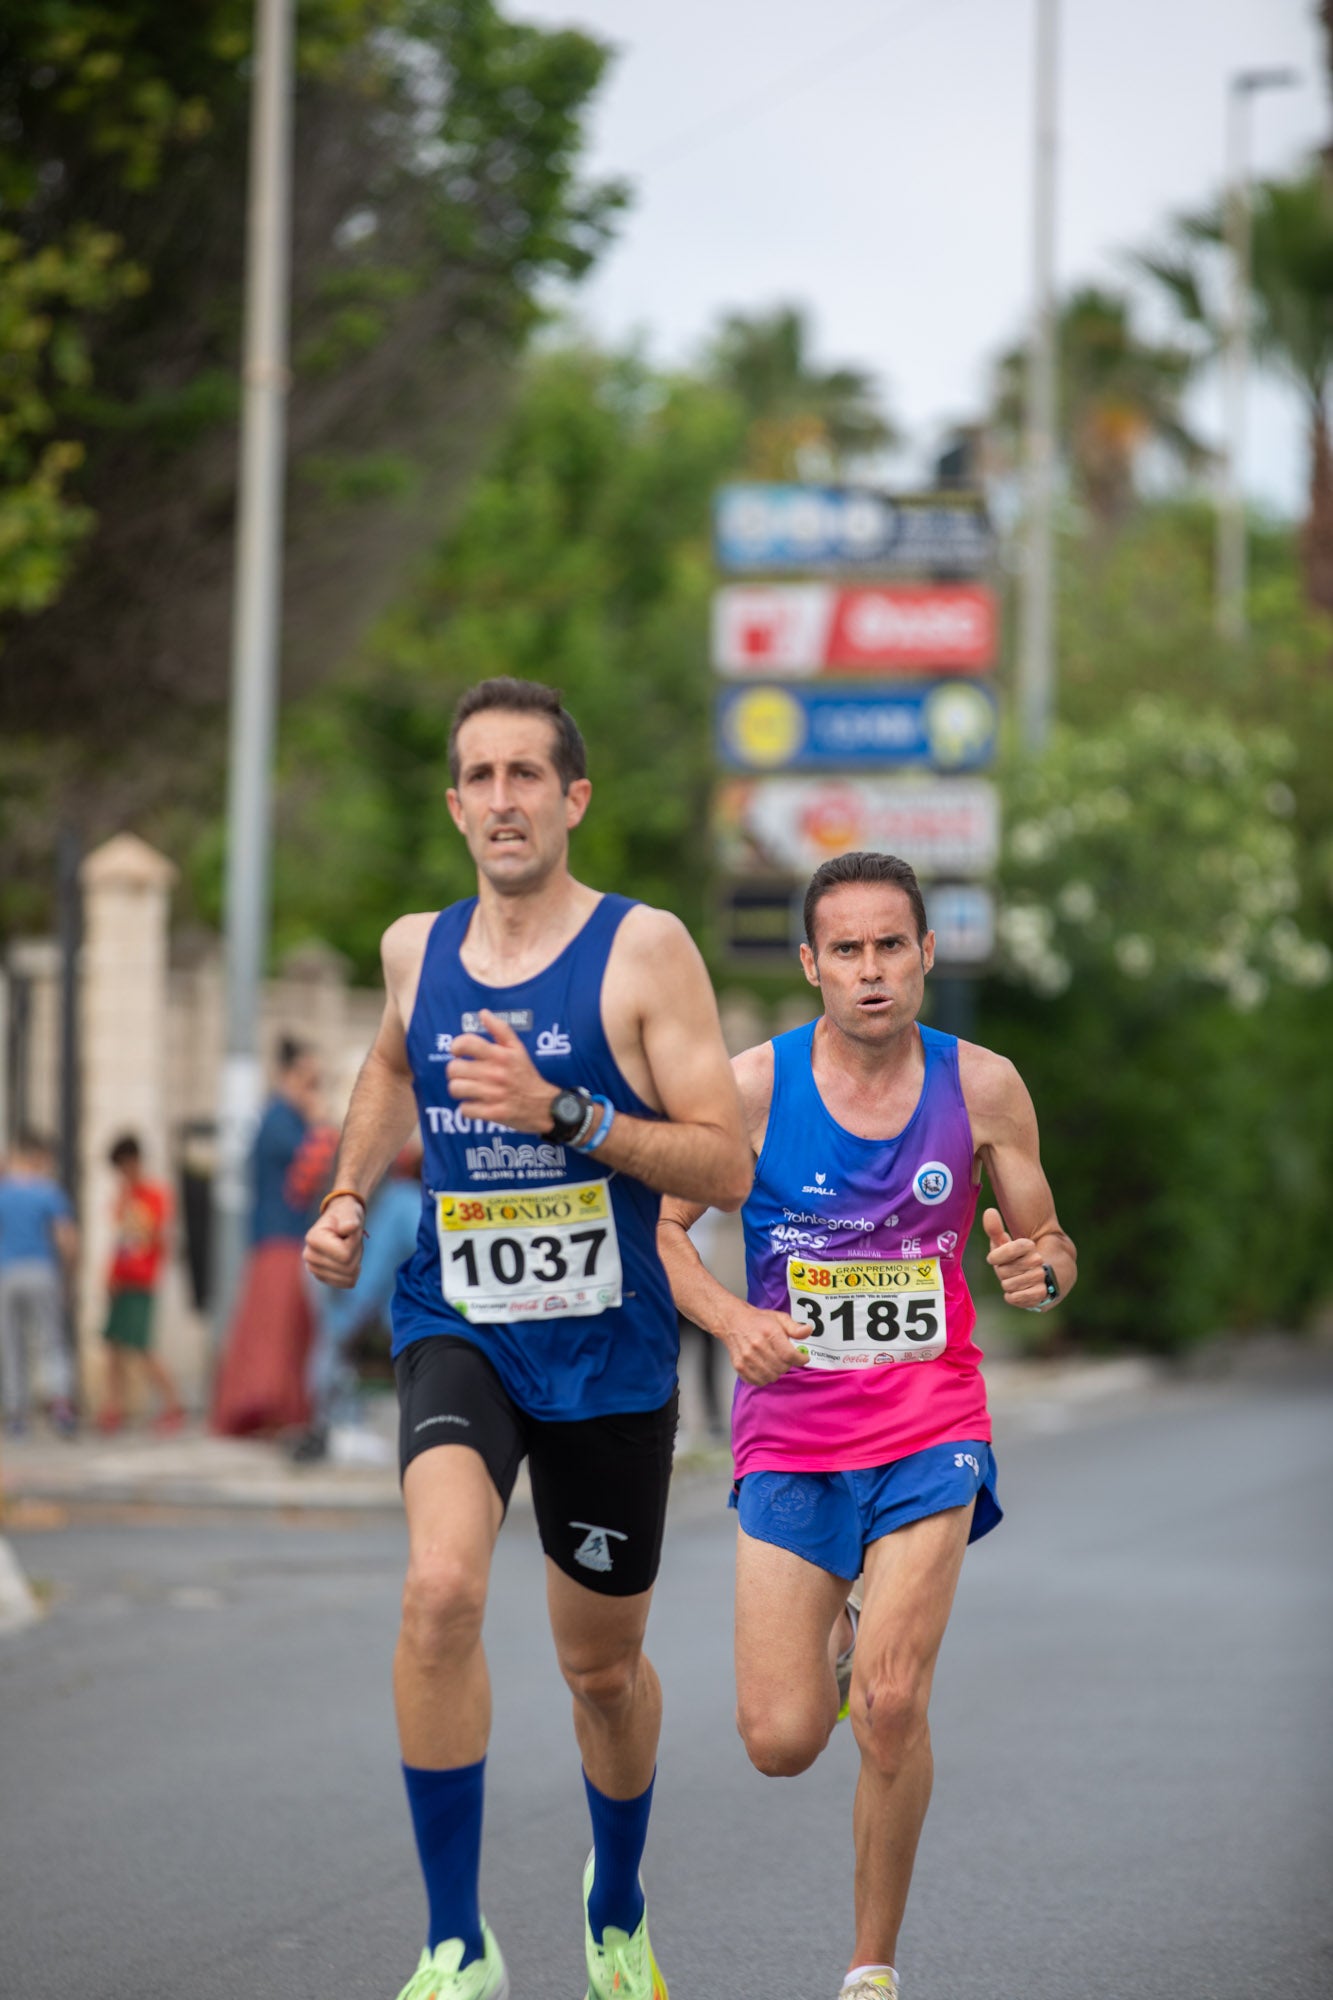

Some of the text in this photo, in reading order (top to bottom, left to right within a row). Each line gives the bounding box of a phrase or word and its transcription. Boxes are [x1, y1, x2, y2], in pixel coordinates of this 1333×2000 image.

[801, 1185, 837, 1196] SPALL
[458, 1201, 485, 1222] 38
[485, 1201, 571, 1221] FONDO
[452, 1228, 607, 1287] 1037
[808, 1268, 832, 1287] 38
[835, 1264, 904, 1274] GRAN PREMIO
[832, 1271, 910, 1288] FONDO
[797, 1297, 938, 1342] 3185
